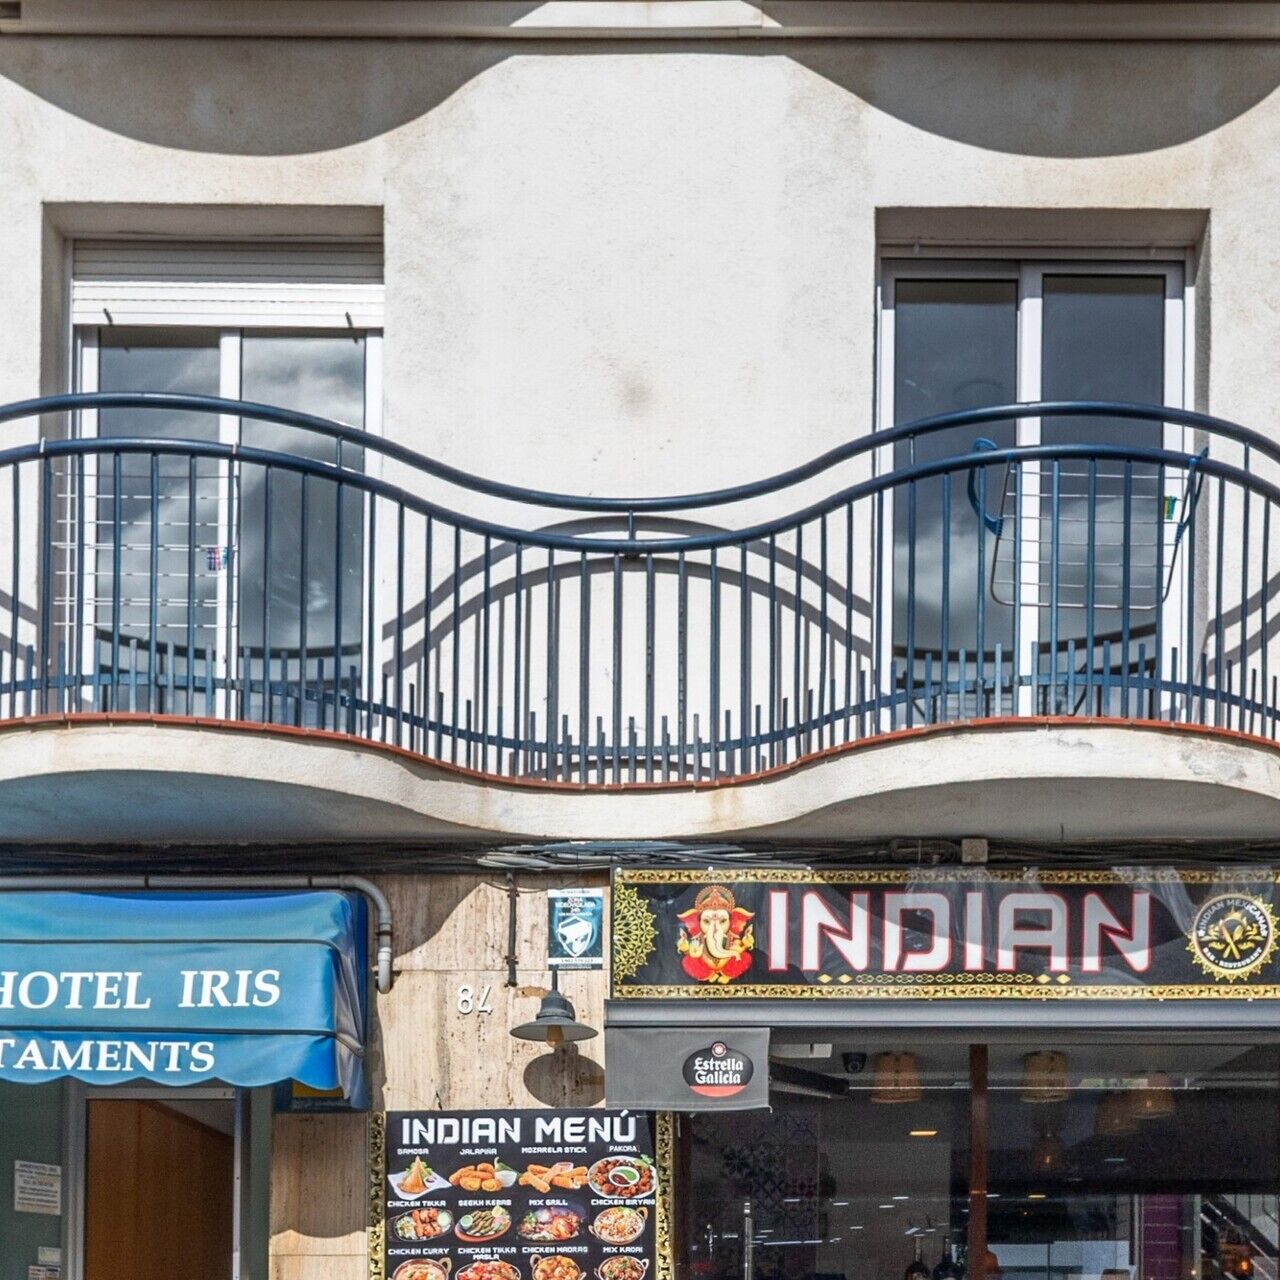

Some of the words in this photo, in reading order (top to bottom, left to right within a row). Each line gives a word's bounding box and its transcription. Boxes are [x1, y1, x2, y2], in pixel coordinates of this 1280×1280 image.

[767, 890, 1153, 974] INDIAN
[1199, 900, 1225, 930] INDIAN
[1227, 898, 1268, 933] MEXICANA
[177, 968, 282, 1008] IRIS
[457, 984, 493, 1015] 84
[693, 1056, 744, 1071] Estrella
[694, 1070, 741, 1085] Galicia
[402, 1117, 520, 1145] INDIAN
[535, 1108, 636, 1143] MENÚ
